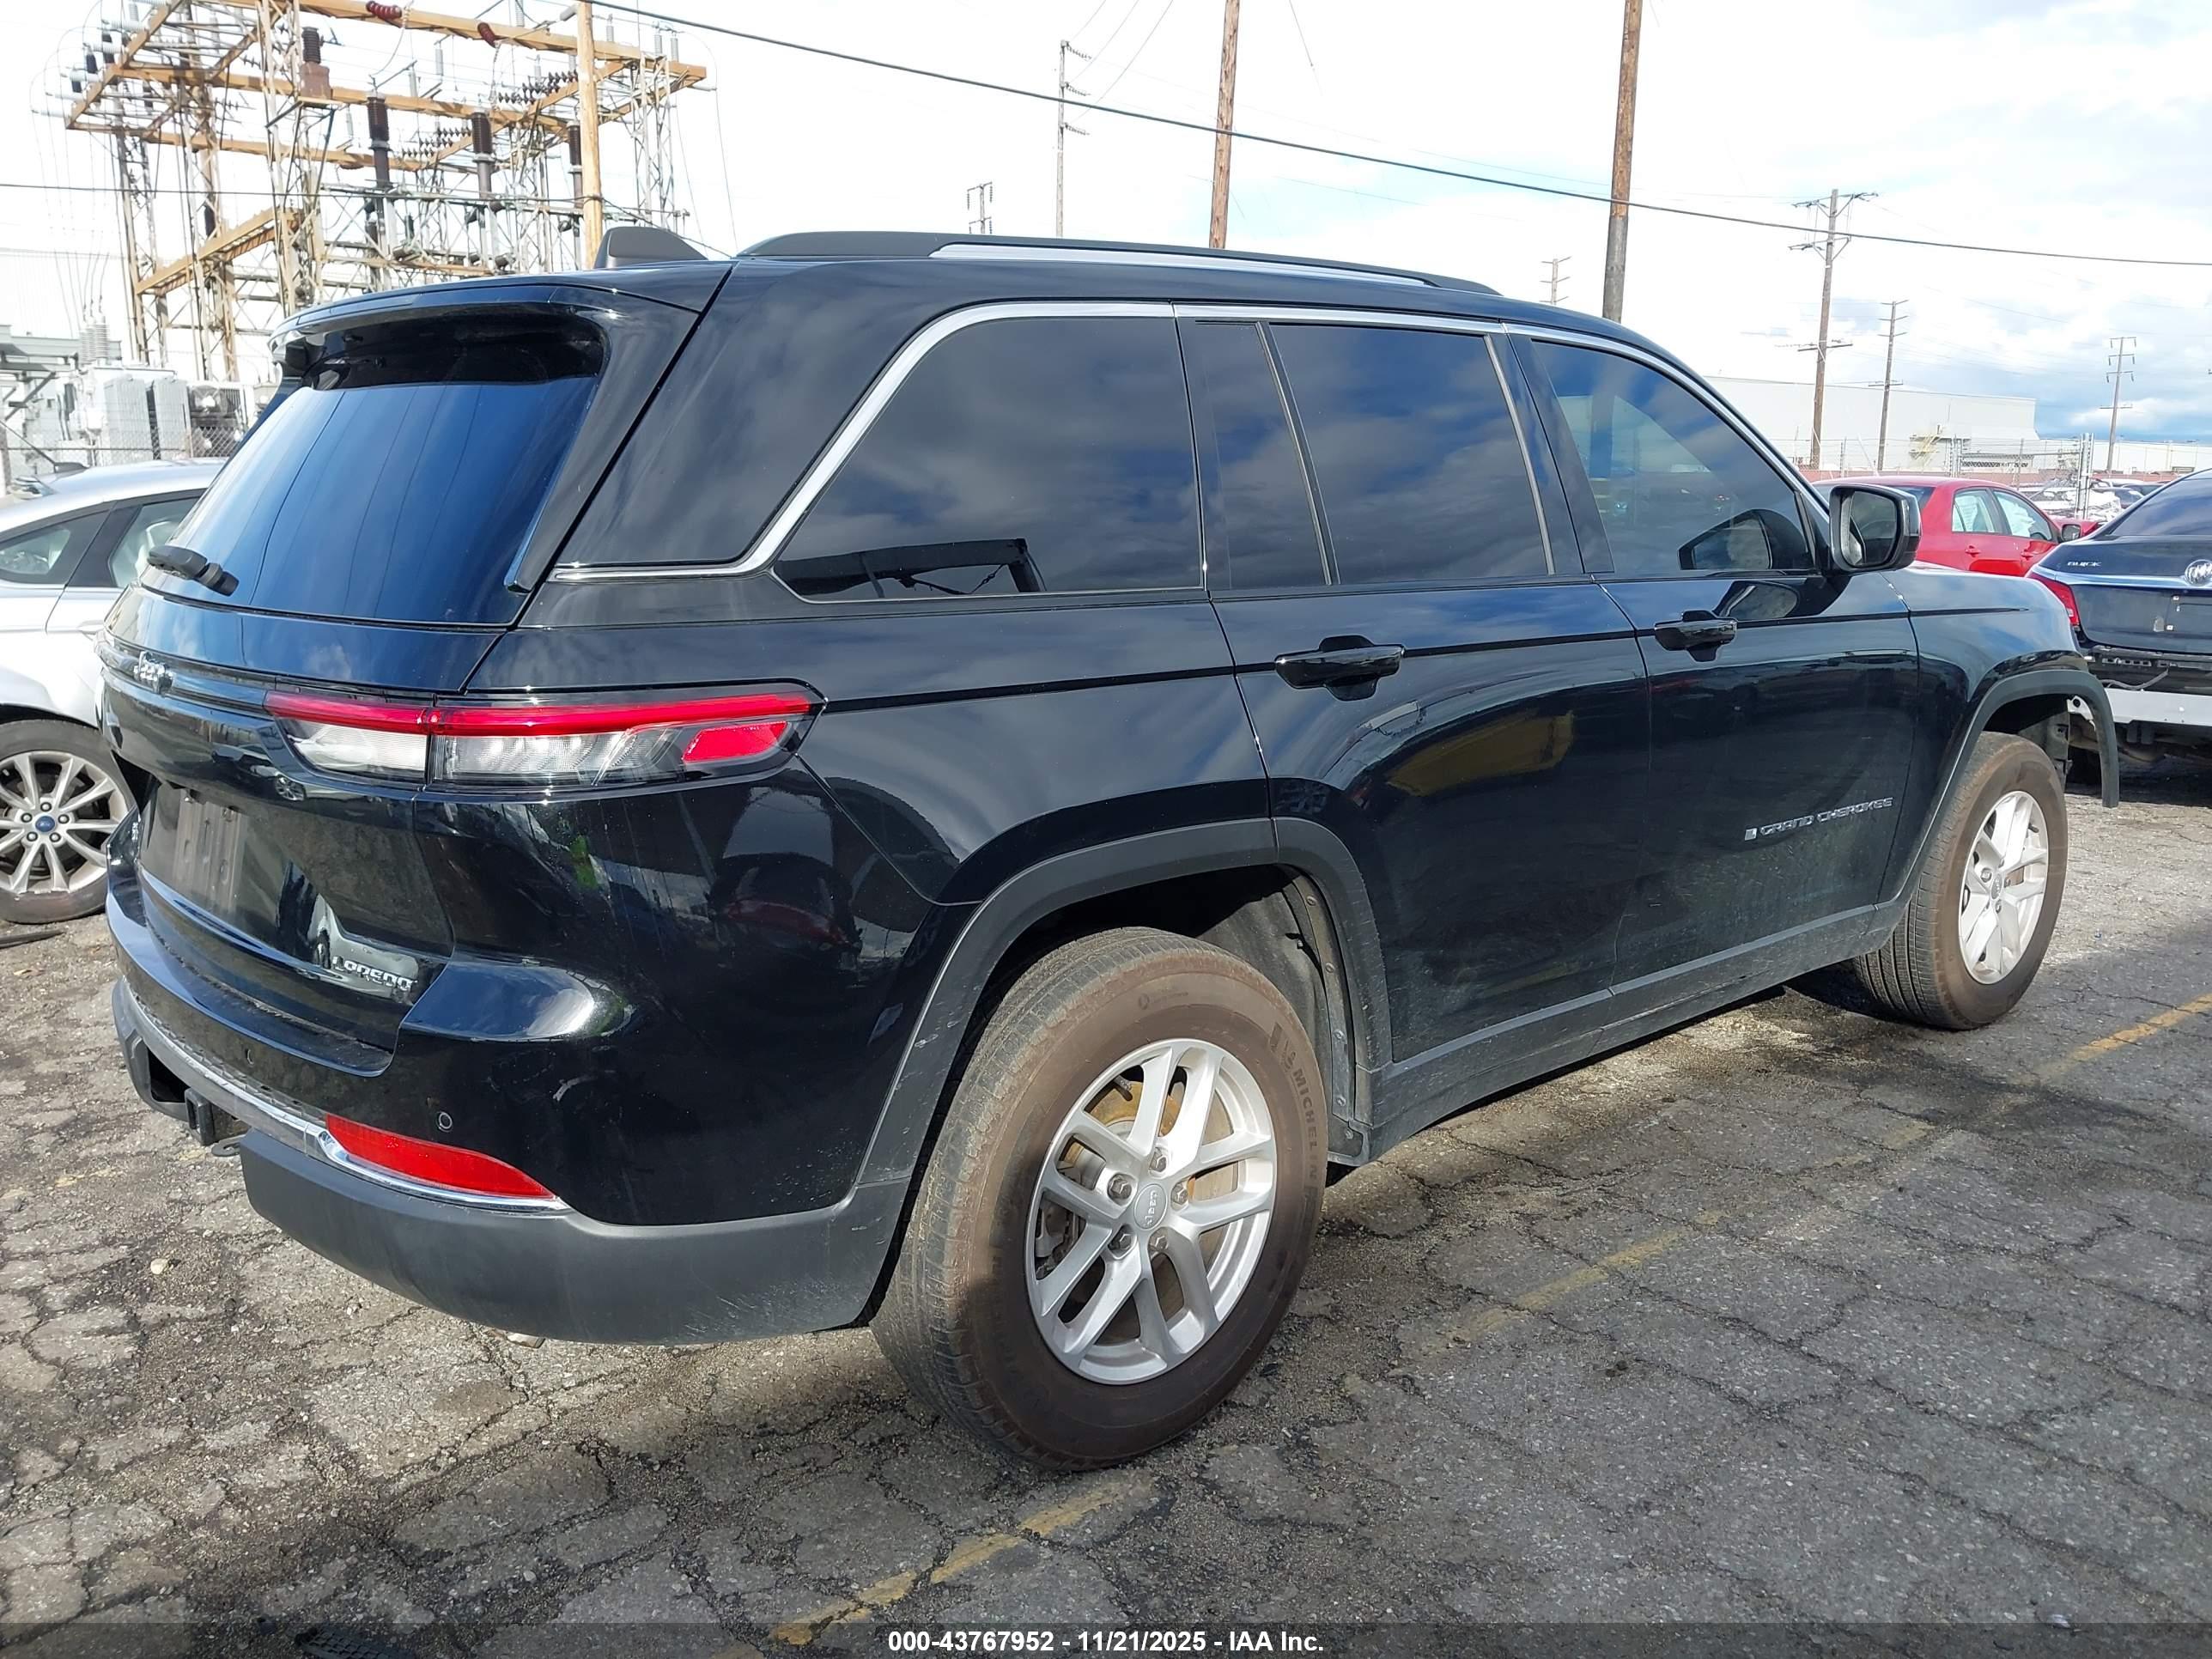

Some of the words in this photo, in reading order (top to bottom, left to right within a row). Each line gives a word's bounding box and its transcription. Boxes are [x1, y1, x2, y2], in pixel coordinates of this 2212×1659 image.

[1760, 815, 1814, 836] GRAND
[1817, 797, 1893, 823] CHEROKEE
[1293, 1067, 1318, 1180] MICHELIN
